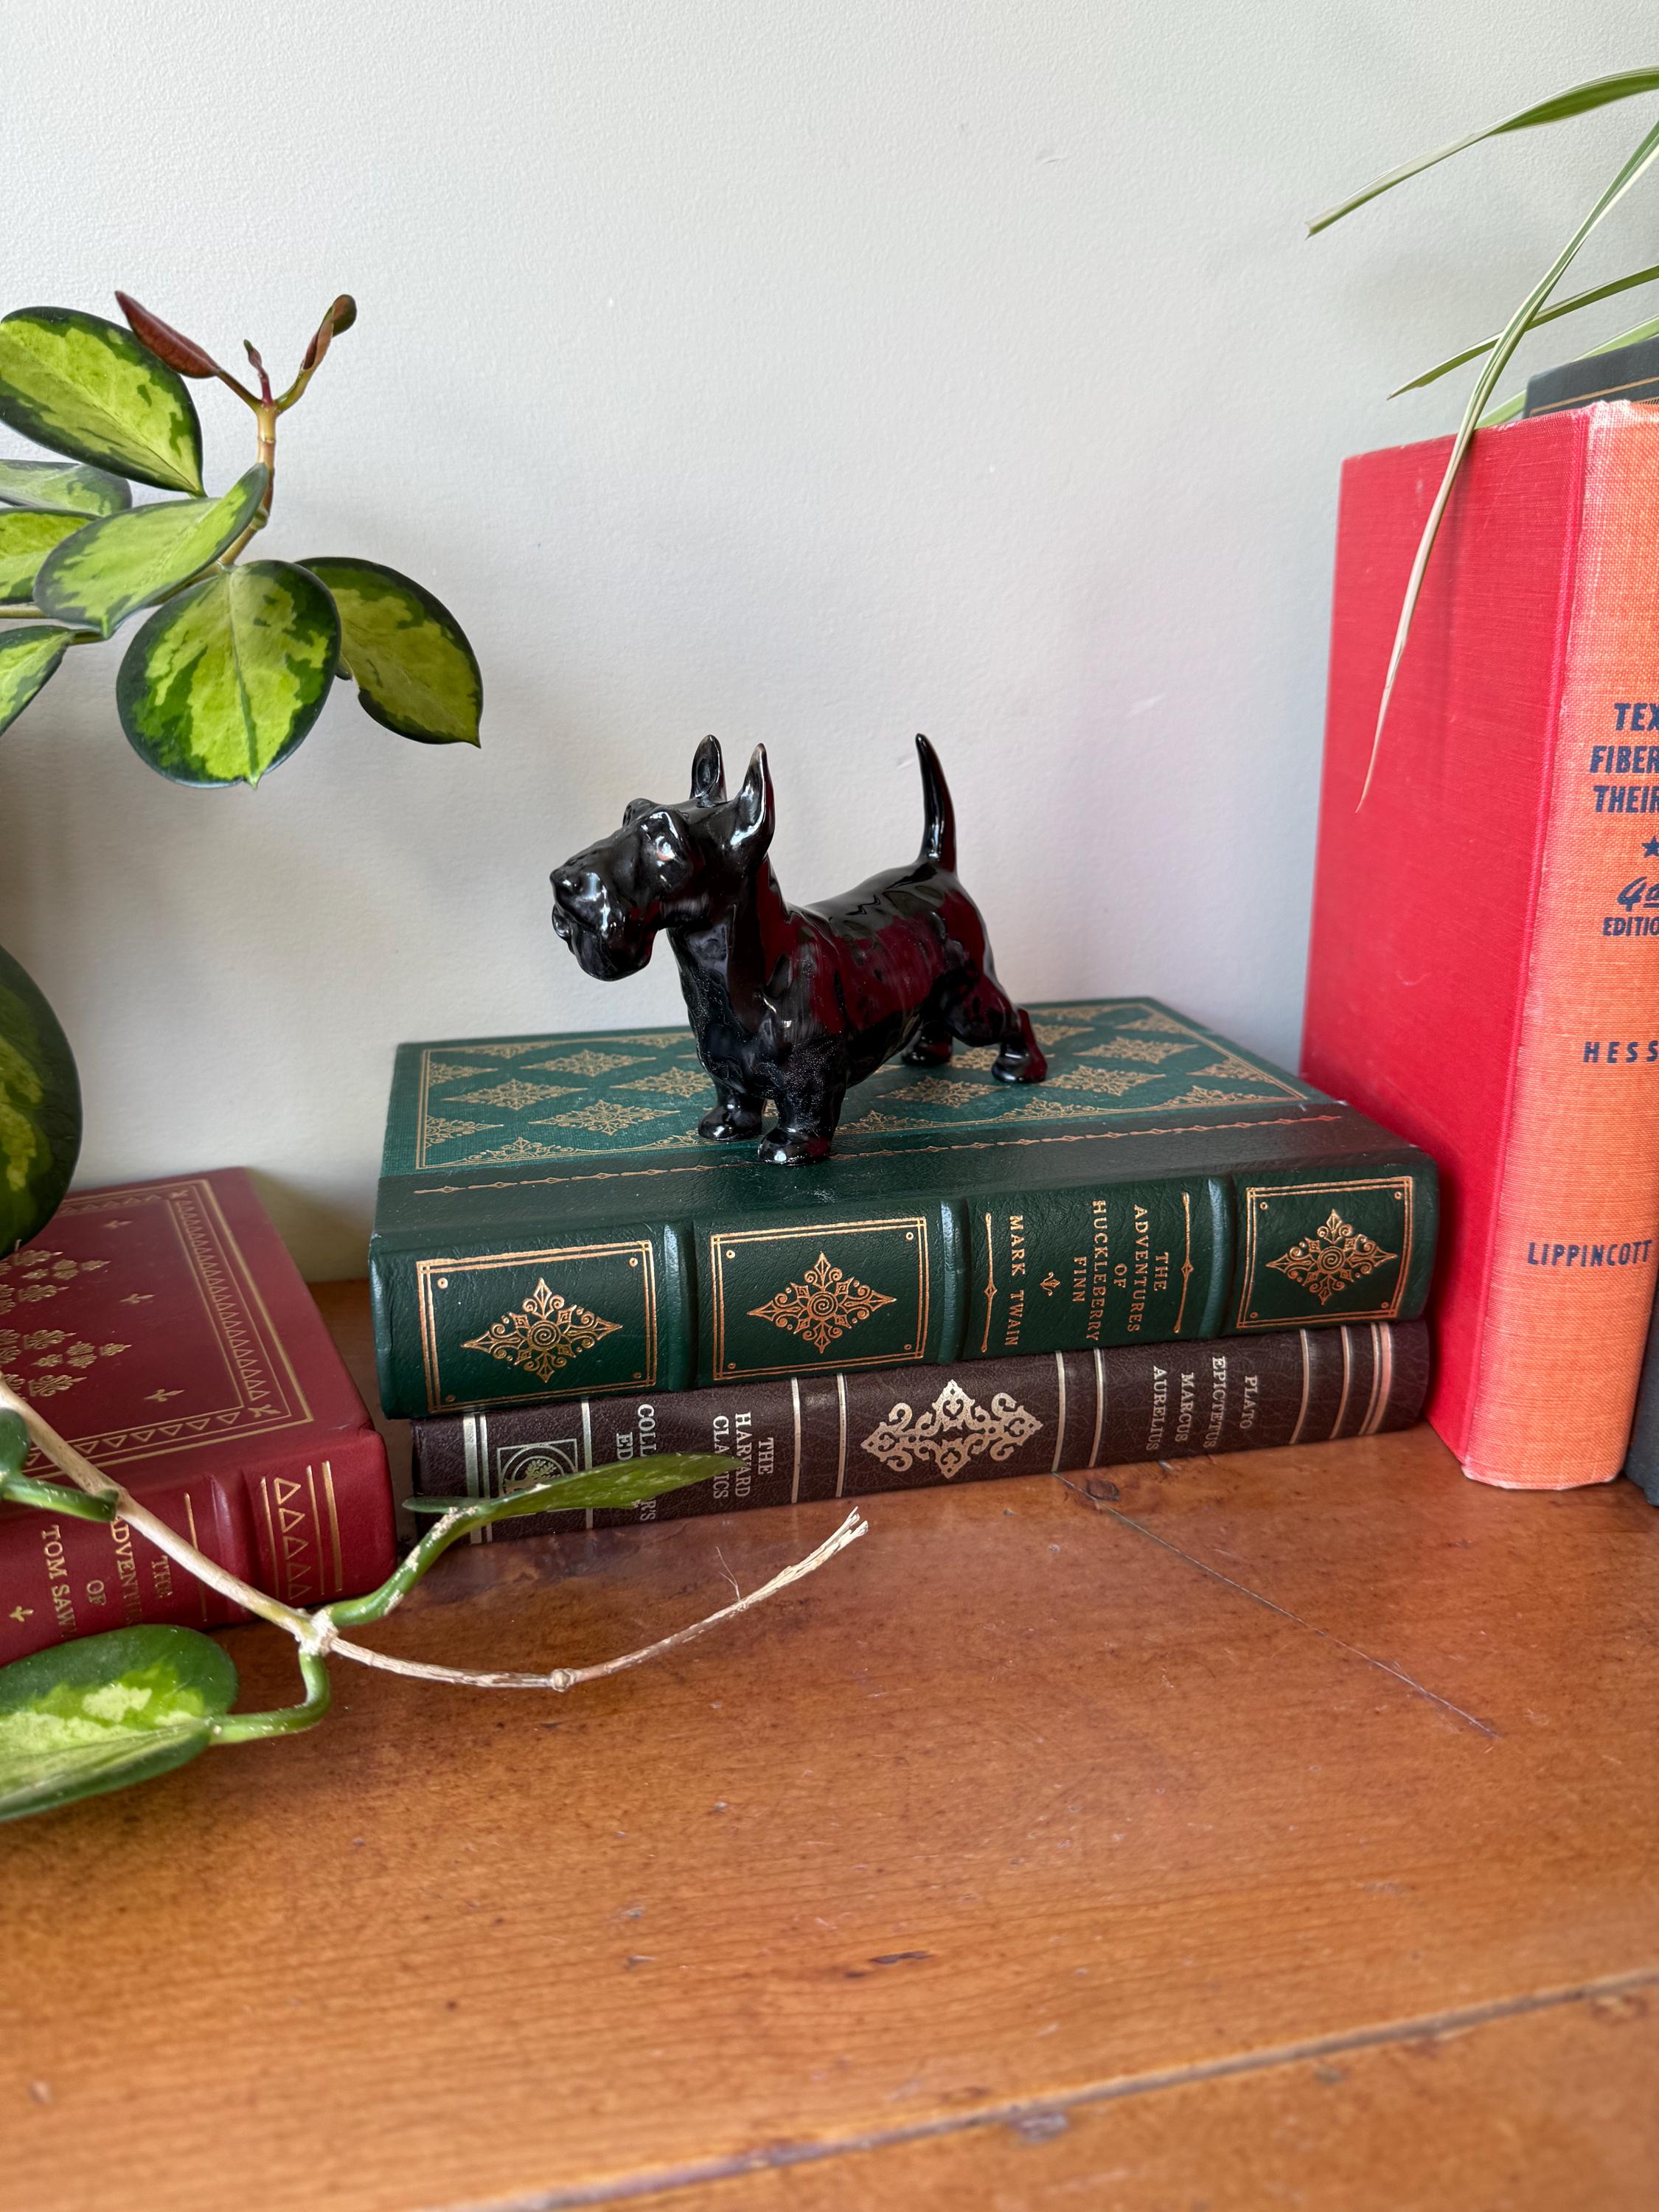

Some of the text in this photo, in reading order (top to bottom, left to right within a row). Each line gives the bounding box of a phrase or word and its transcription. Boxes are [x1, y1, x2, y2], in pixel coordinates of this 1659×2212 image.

[1583, 1040, 1658, 1063] HESS
[1004, 1214, 1026, 1346] MARK TWAIN
[1073, 1256, 1088, 1302] FINN
[1085, 1200, 1108, 1341] HUCKLEBERRY
[1114, 1263, 1127, 1289] OF
[1127, 1204, 1150, 1332] ADVENTURES
[1153, 1251, 1169, 1292] THE
[1527, 1239, 1653, 1267] LIPPINCOTT
[1146, 1365, 1169, 1451] AURELIUS
[1175, 1371, 1196, 1443] MARCUS
[1203, 1356, 1227, 1449] EPICTETUS
[1239, 1375, 1258, 1430] PLATO
[713, 1415, 730, 1499] CLAICS
[758, 1437, 774, 1475] THE
[41, 1524, 68, 1579] TOM
[86, 1579, 106, 1606] OF
